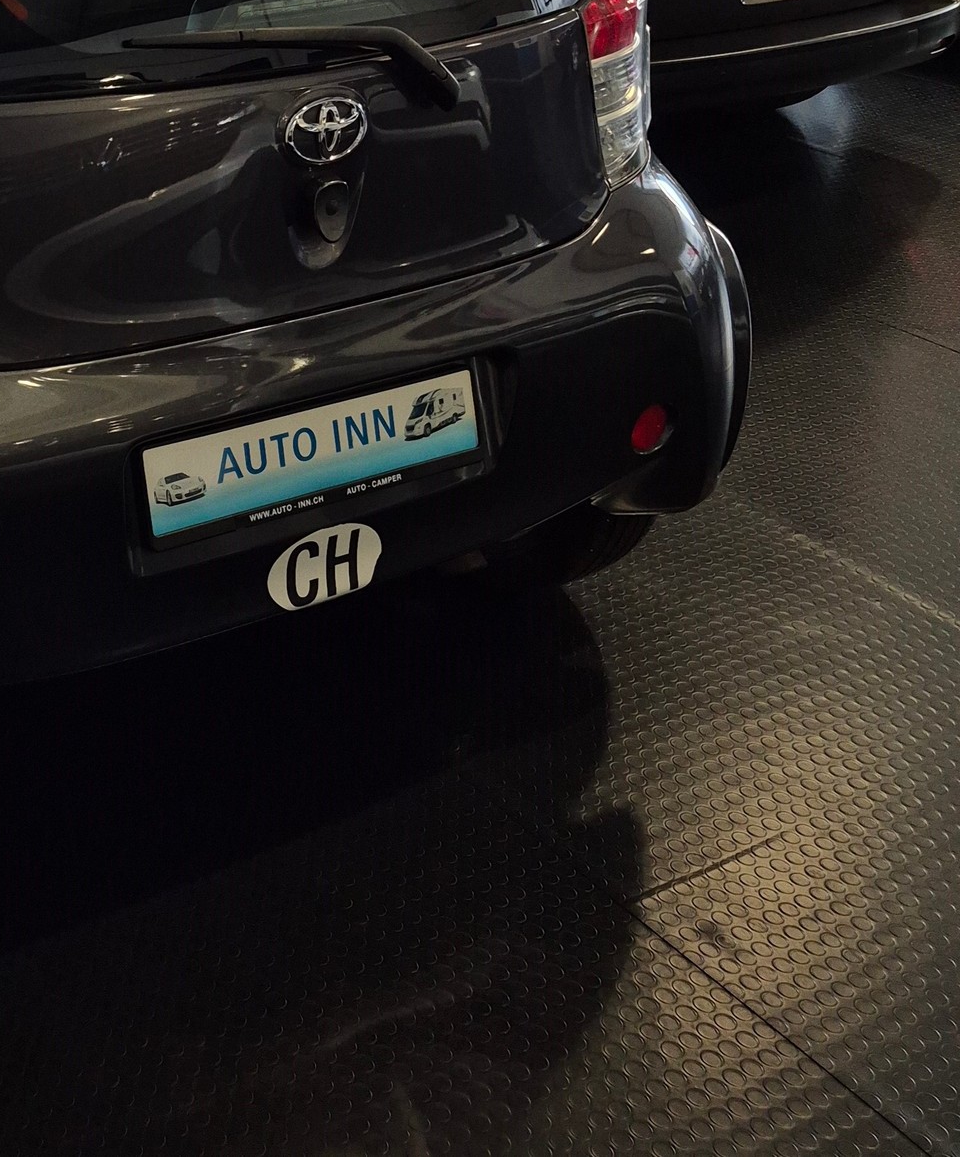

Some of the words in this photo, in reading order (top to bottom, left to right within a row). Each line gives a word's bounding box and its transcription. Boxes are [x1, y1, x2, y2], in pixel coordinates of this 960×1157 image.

[217, 427, 317, 484] AUTO
[332, 405, 396, 453] INN
[249, 503, 293, 522] WWW.AUTO
[298, 495, 324, 510] INN.CH
[346, 483, 367, 495] AUTO
[371, 474, 402, 489] CAMPER
[286, 528, 361, 609] CH
